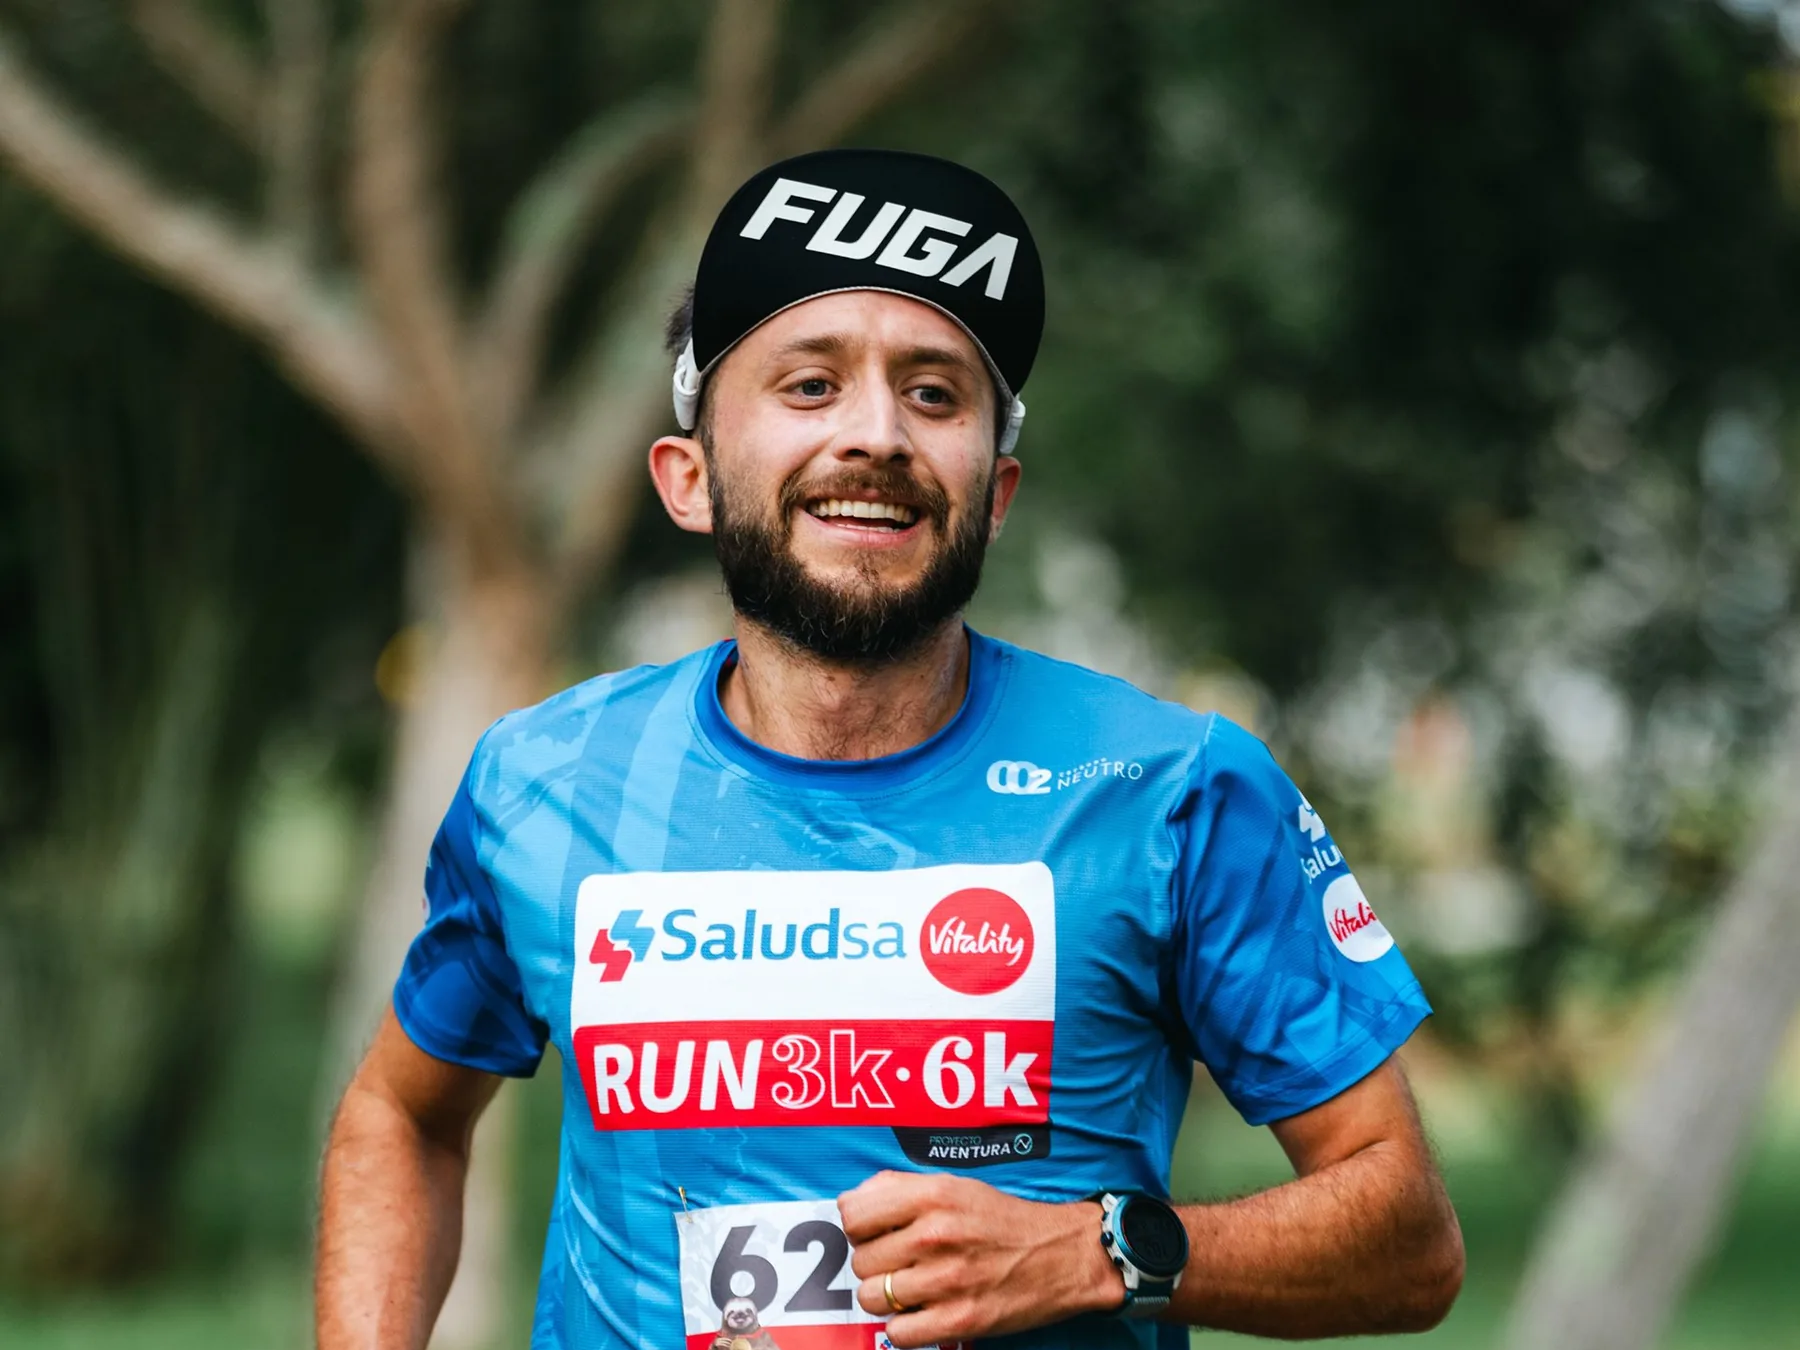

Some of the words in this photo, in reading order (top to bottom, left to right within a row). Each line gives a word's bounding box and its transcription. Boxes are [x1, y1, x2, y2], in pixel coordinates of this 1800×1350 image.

[740, 177, 1019, 301] FUGA
[1057, 759, 1143, 791] NEUTRO
[661, 907, 907, 961] Saludsa
[929, 916, 1025, 966] Vitality
[928, 1143, 1011, 1159] AVENTURA
[929, 1135, 982, 1146] PROYECTO
[710, 1219, 853, 1313] 62
